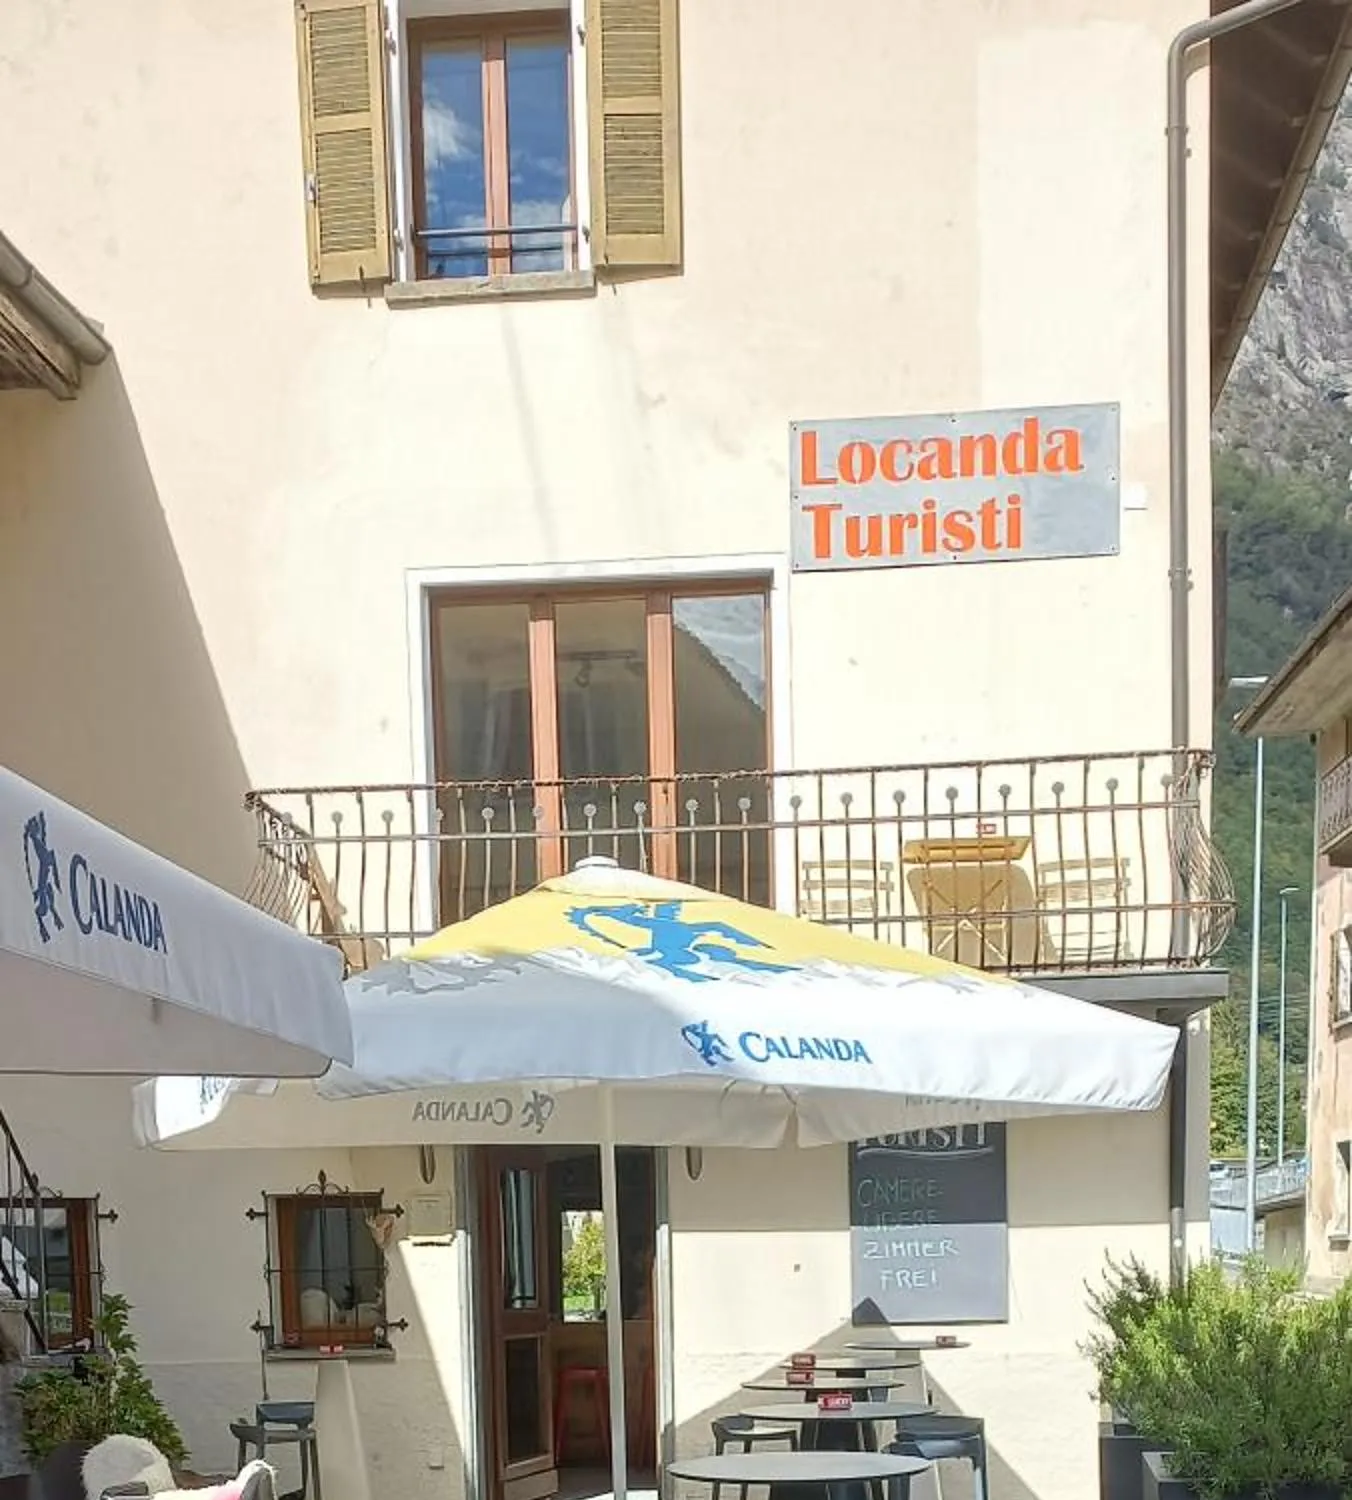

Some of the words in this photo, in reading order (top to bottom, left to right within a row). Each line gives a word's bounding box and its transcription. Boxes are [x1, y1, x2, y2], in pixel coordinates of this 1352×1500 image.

[800, 417, 1084, 486] Locanda
[801, 493, 1022, 559] Turisti
[69, 853, 168, 954] CALANDA
[738, 1031, 873, 1065] CALANDA
[863, 1237, 960, 1260] ZIMMER
[881, 1266, 937, 1291] FREI
